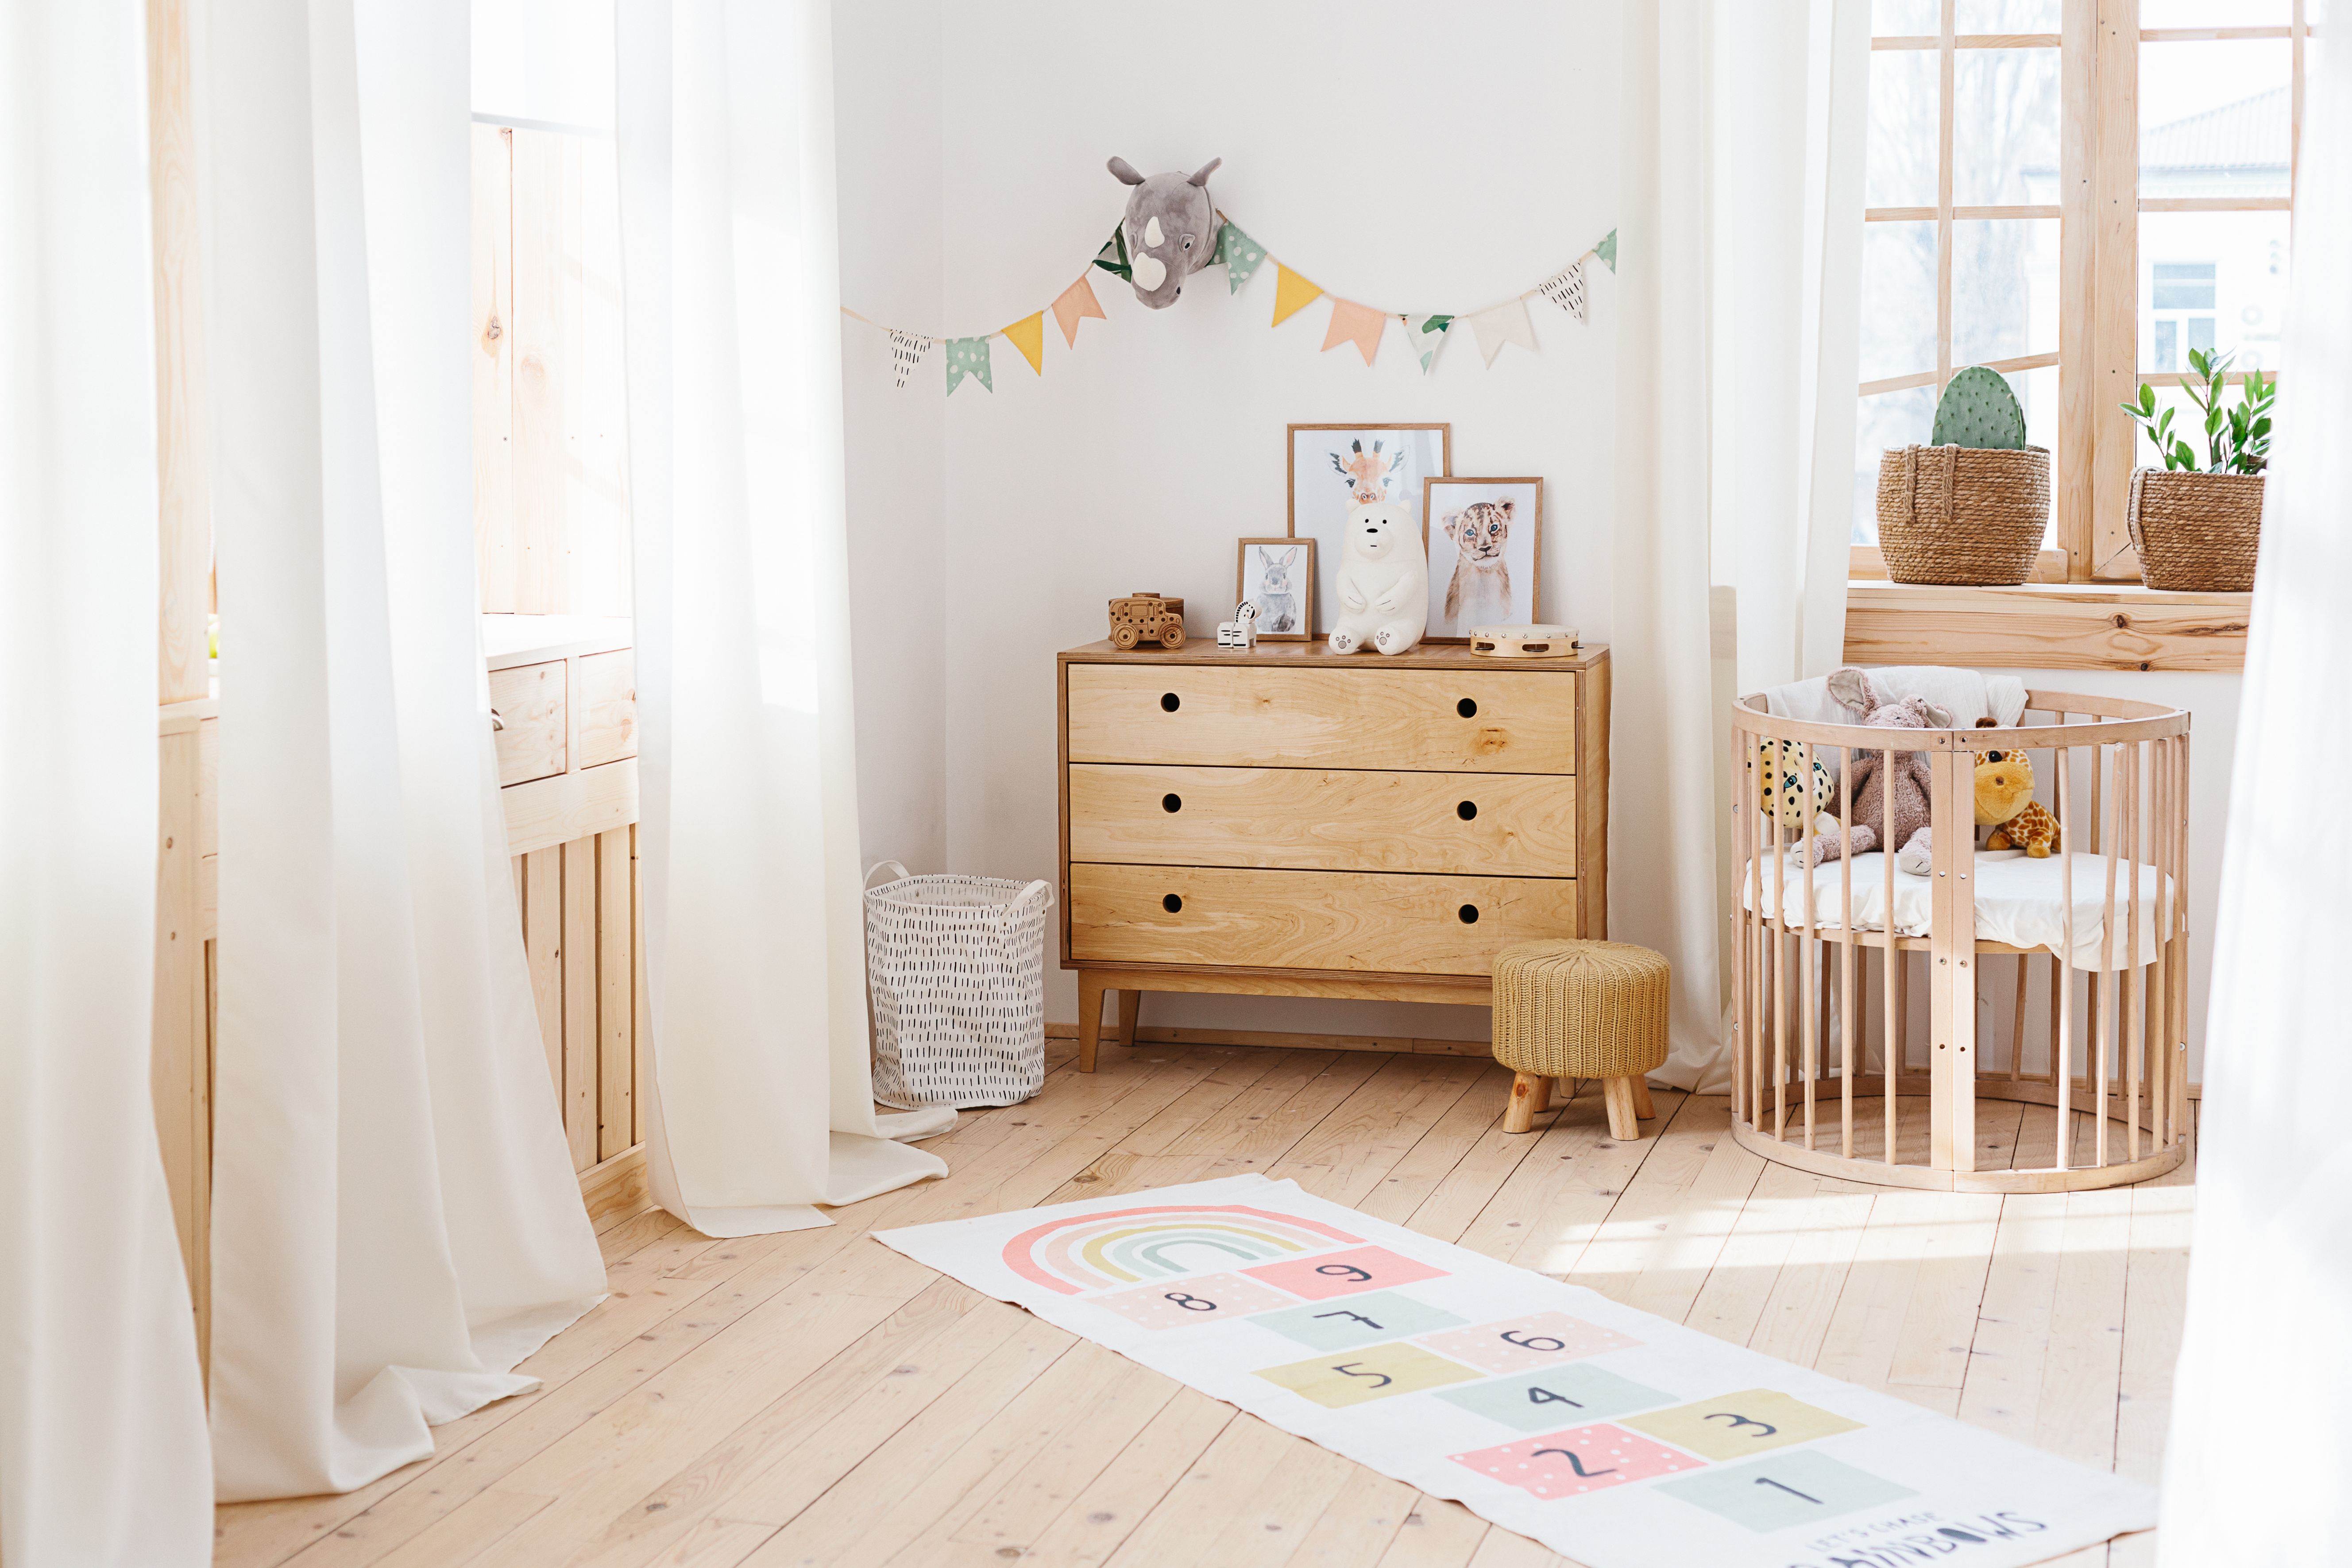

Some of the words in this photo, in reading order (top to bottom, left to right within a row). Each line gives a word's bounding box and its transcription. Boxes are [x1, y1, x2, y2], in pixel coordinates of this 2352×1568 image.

[1315, 1264, 1372, 1282] 9
[1164, 1292, 1217, 1312] 8
[1312, 1310, 1384, 1329] 7
[1500, 1330, 1565, 1351] 6
[1332, 1363, 1392, 1388] 5
[1527, 1386, 1584, 1408] 4
[1703, 1414, 1777, 1437] 3
[1531, 1448, 1618, 1477] 2
[1754, 1477, 1824, 1504] 1
[1867, 1512, 1943, 1532] CHASE
